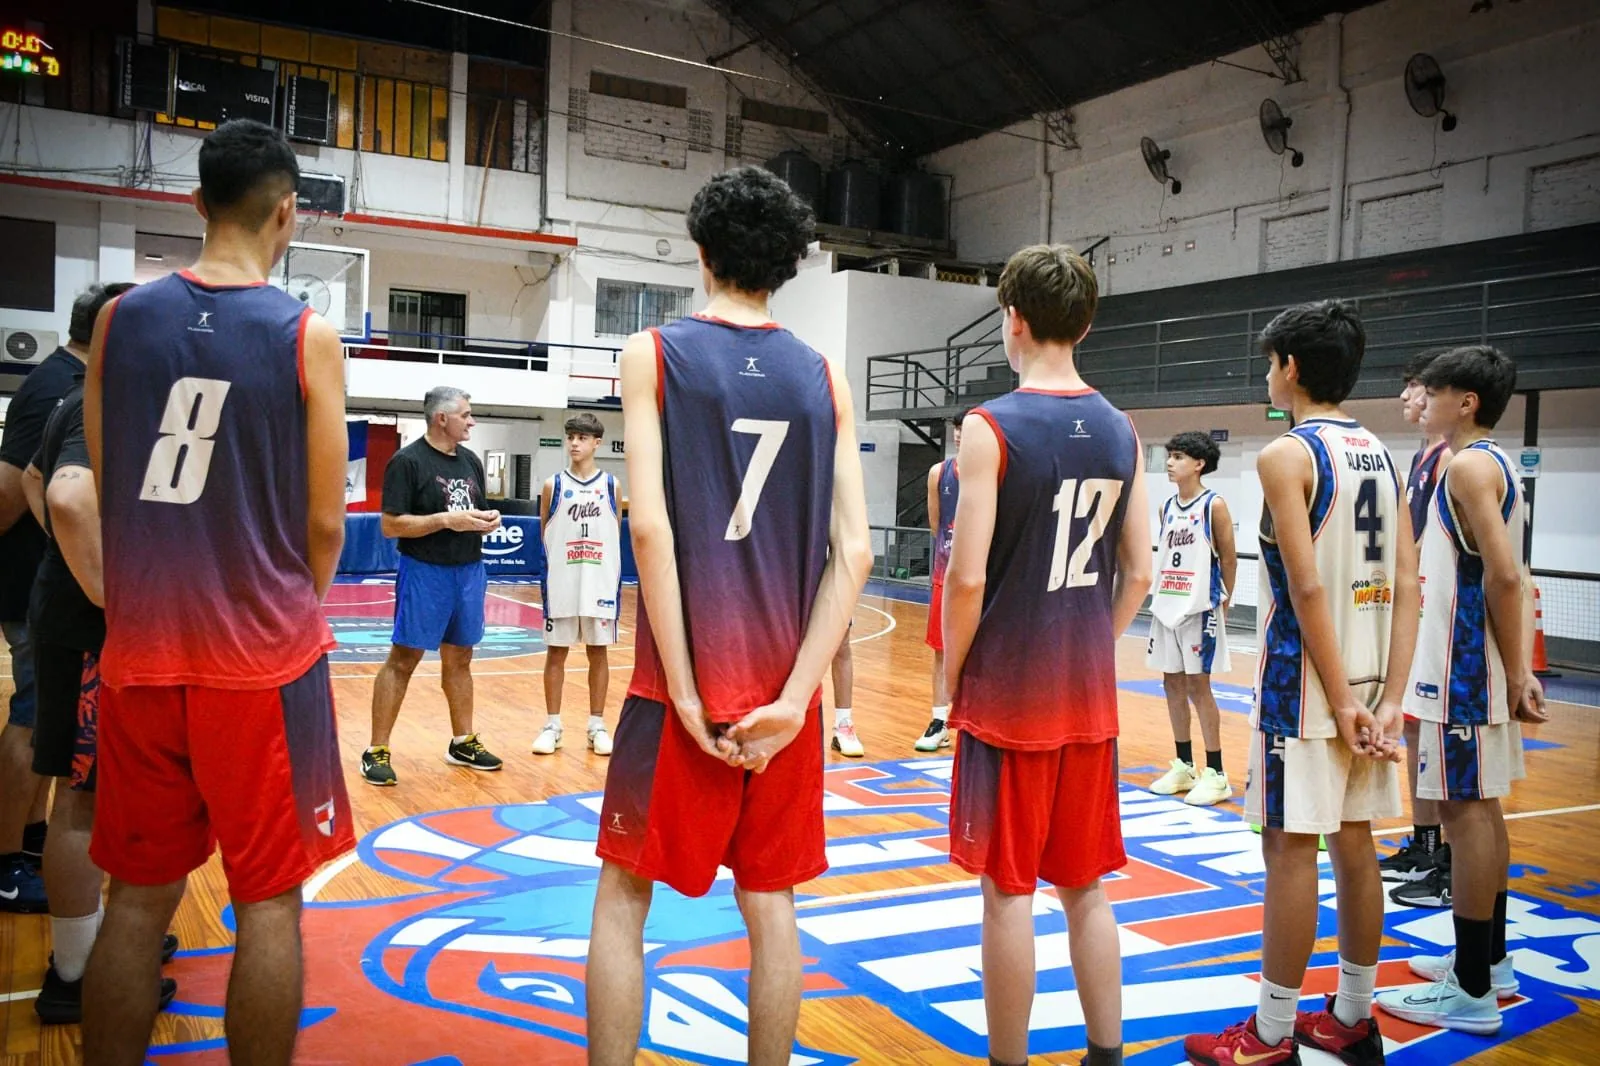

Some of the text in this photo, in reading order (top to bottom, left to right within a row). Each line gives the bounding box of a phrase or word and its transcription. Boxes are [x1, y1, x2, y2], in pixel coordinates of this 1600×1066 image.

[179, 80, 207, 93] LOCAL
[245, 93, 270, 105] VISITA
[139, 376, 232, 505] 8
[724, 418, 790, 541] 7
[567, 501, 602, 522] Villa
[1354, 478, 1382, 562] 4
[581, 523, 589, 538] 11
[1047, 478, 1124, 592] 12
[1166, 526, 1196, 549] Villa
[1171, 551, 1182, 568] 8
